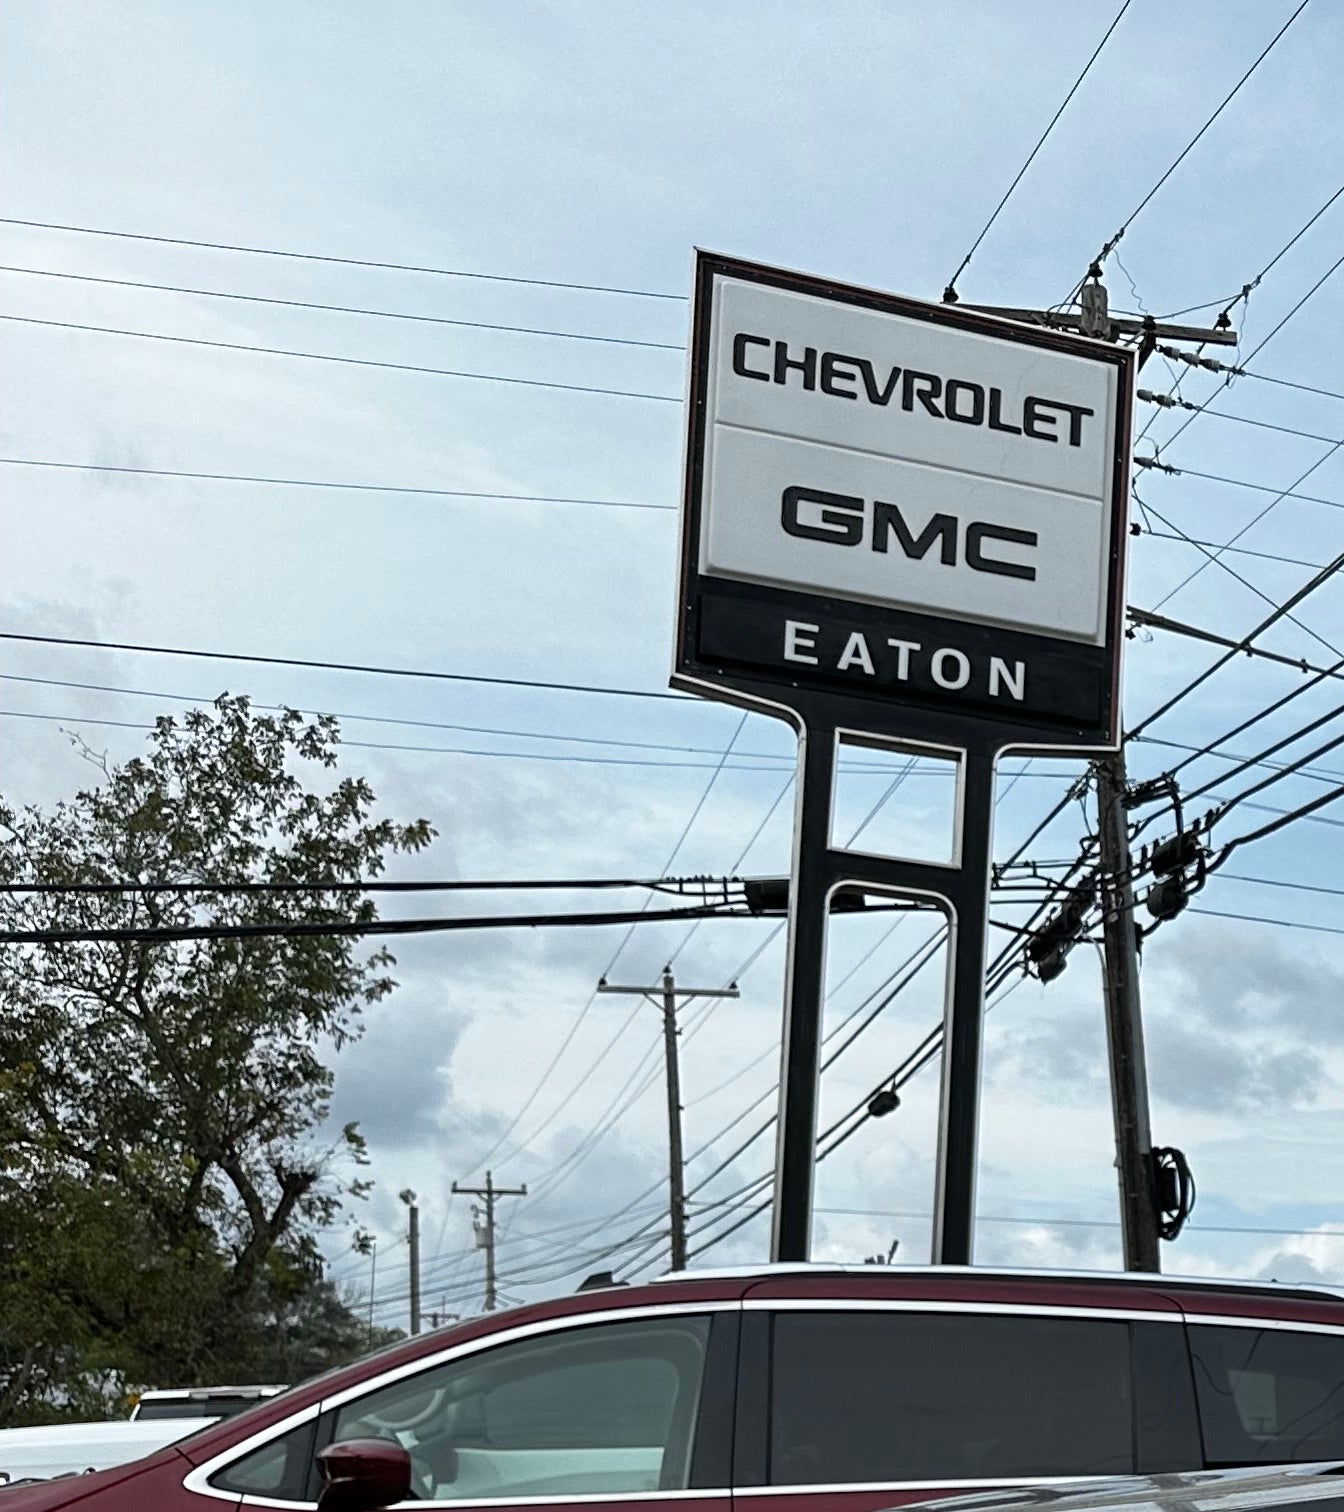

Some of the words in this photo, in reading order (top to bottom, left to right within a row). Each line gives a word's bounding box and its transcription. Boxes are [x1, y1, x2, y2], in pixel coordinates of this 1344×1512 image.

[732, 332, 1094, 447] CHEVROLET
[781, 485, 1038, 582] GMC
[783, 620, 1025, 701] EATON
